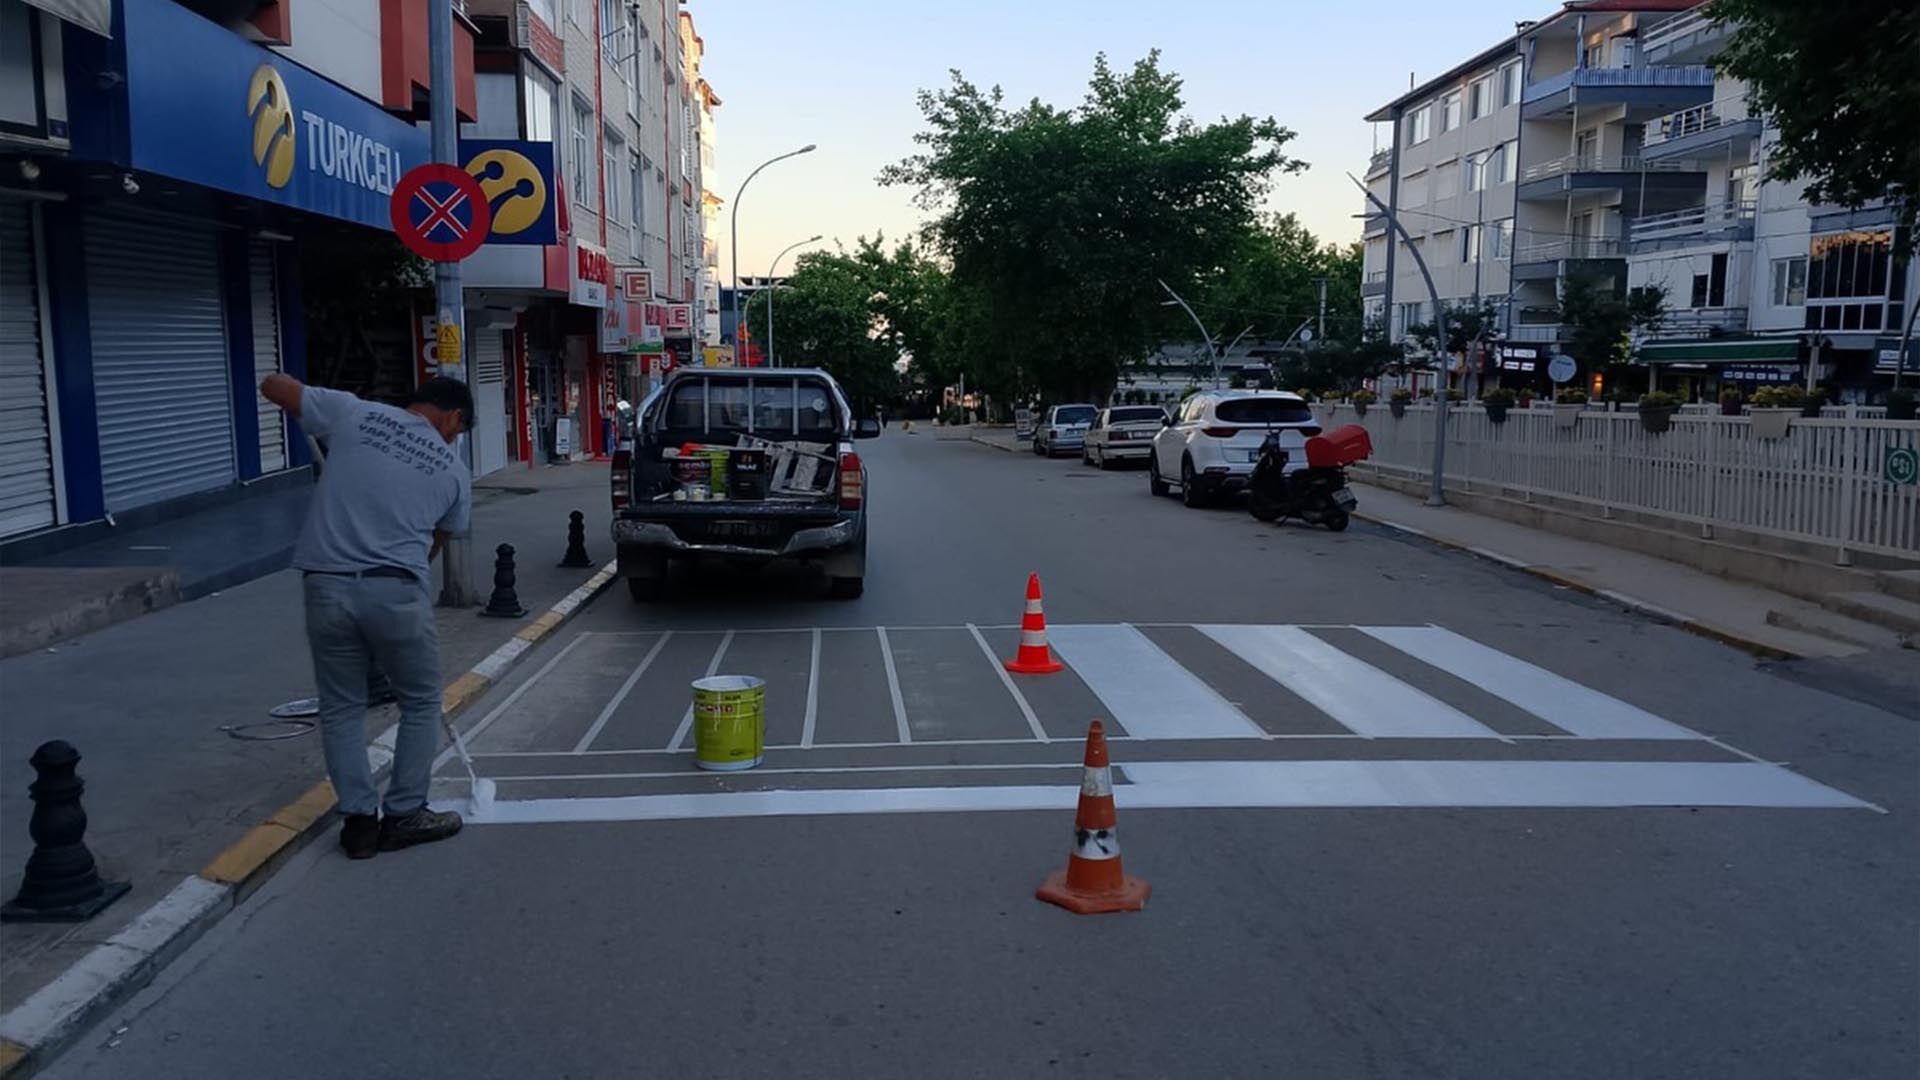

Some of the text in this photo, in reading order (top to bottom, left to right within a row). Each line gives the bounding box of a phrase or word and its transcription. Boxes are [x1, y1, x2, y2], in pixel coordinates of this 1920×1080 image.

[629, 277, 646, 295] E
[674, 309, 686, 322] E
[358, 423, 449, 471] YAPI MARKET
